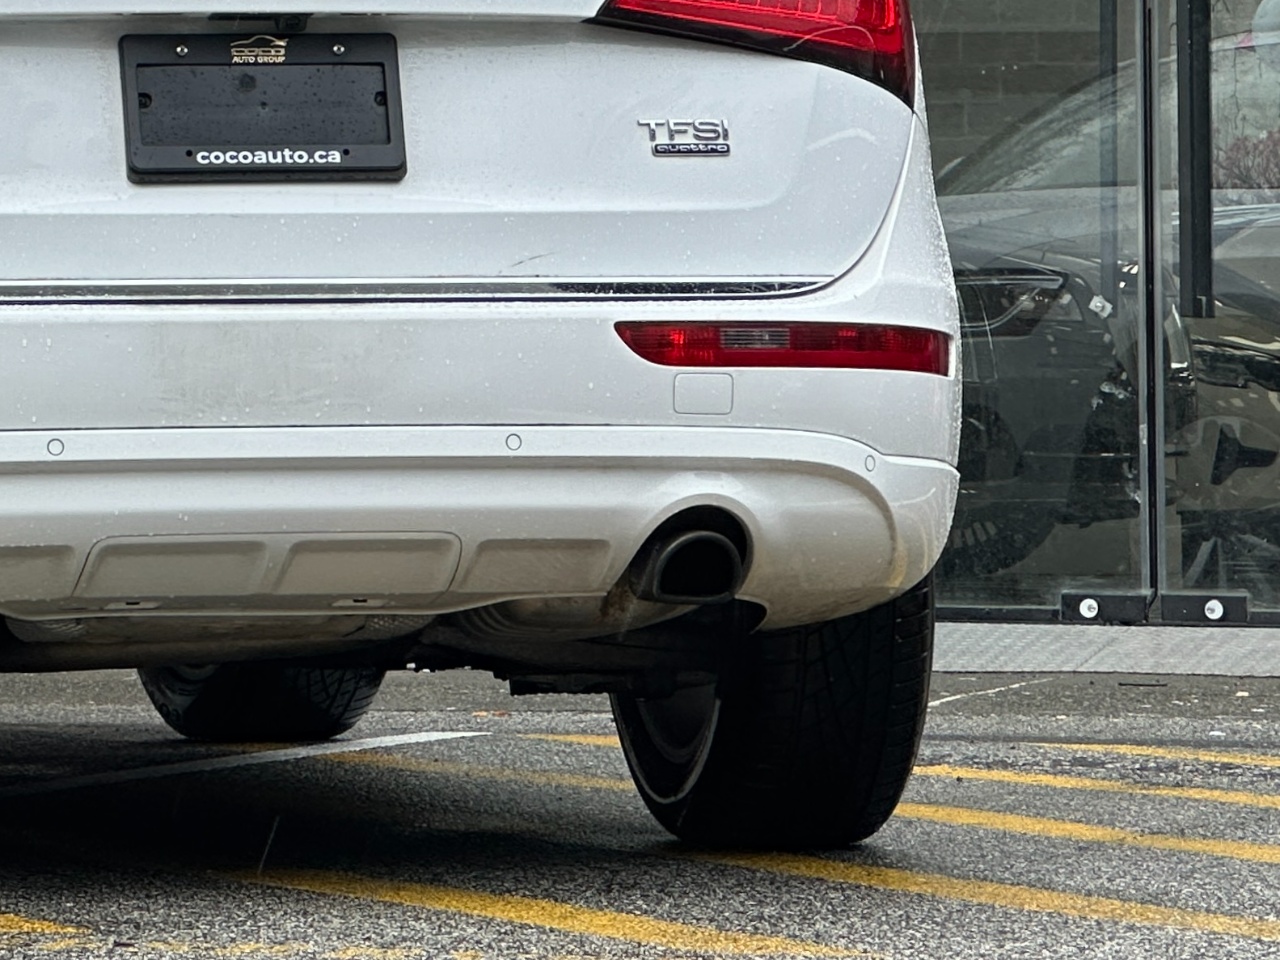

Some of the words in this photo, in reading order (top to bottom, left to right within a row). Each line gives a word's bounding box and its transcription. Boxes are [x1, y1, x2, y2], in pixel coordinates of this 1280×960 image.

[637, 118, 729, 142] TFSI
[196, 148, 341, 164] cocoauto.ca
[656, 144, 728, 153] quattro
